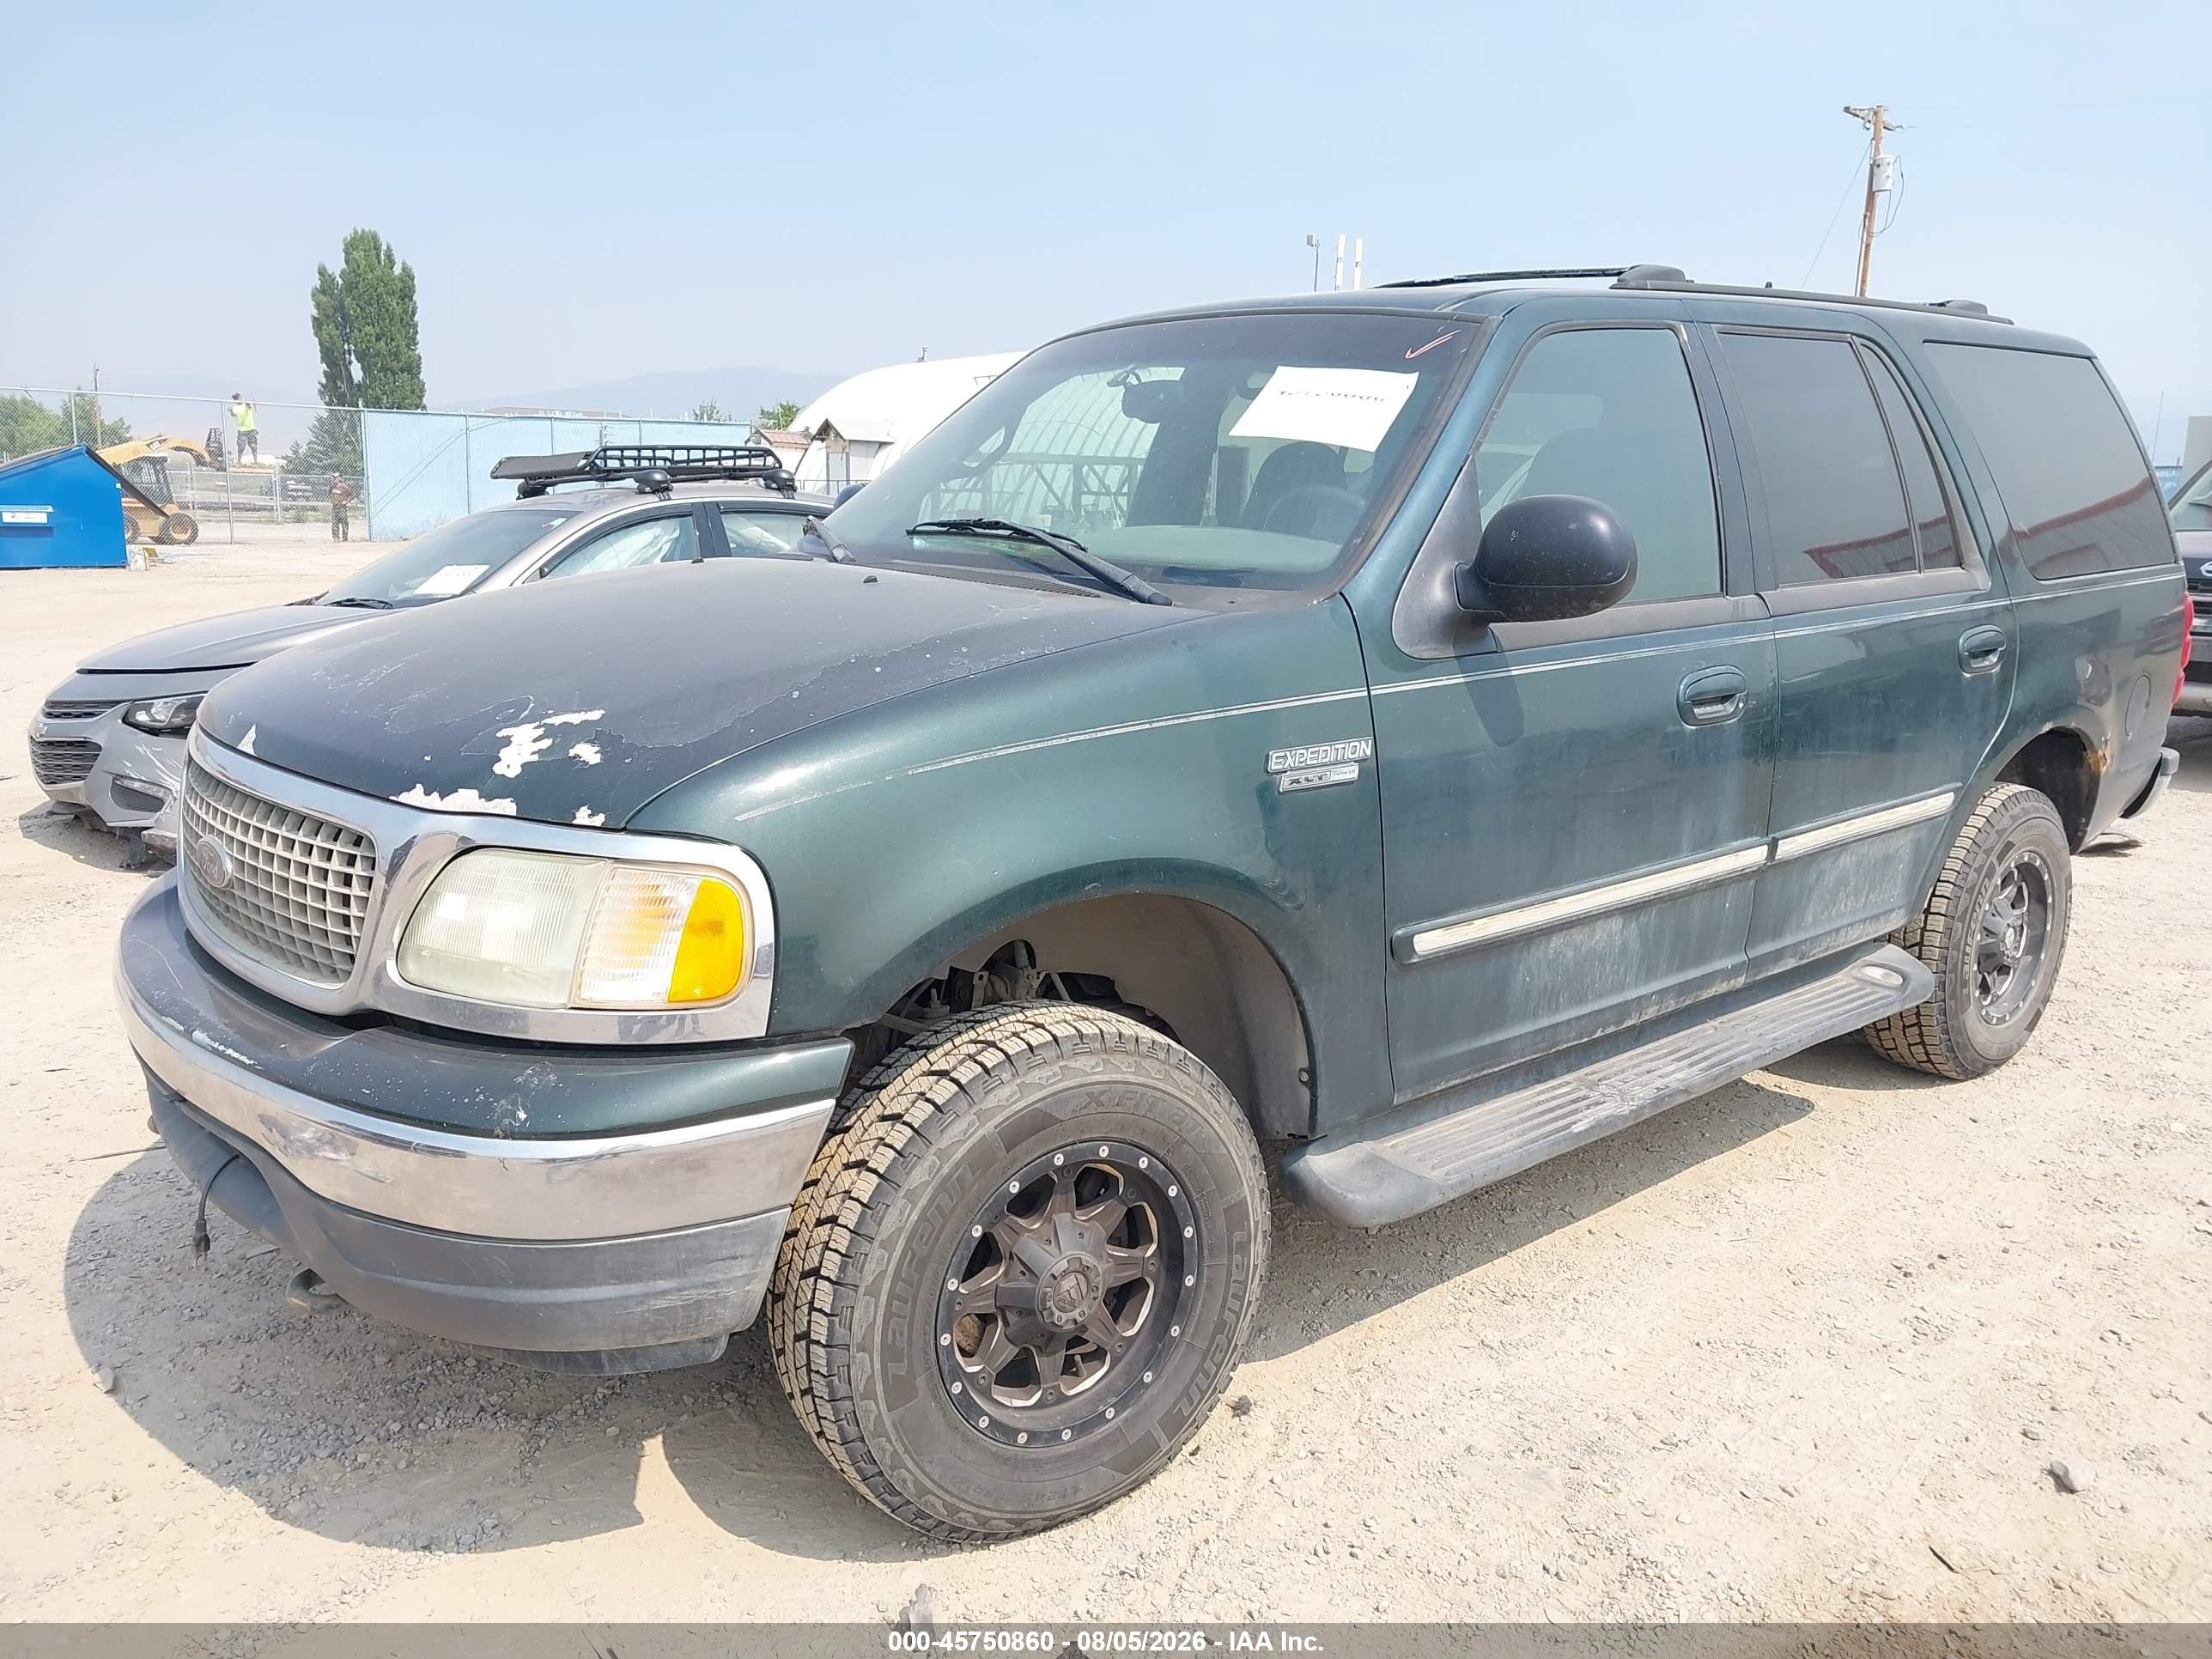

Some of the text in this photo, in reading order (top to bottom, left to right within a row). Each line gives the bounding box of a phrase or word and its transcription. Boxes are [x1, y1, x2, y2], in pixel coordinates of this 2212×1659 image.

[1270, 739, 1372, 770] EXPEDITION
[1289, 774, 1328, 786] XLT
[202, 847, 219, 880] Ford
